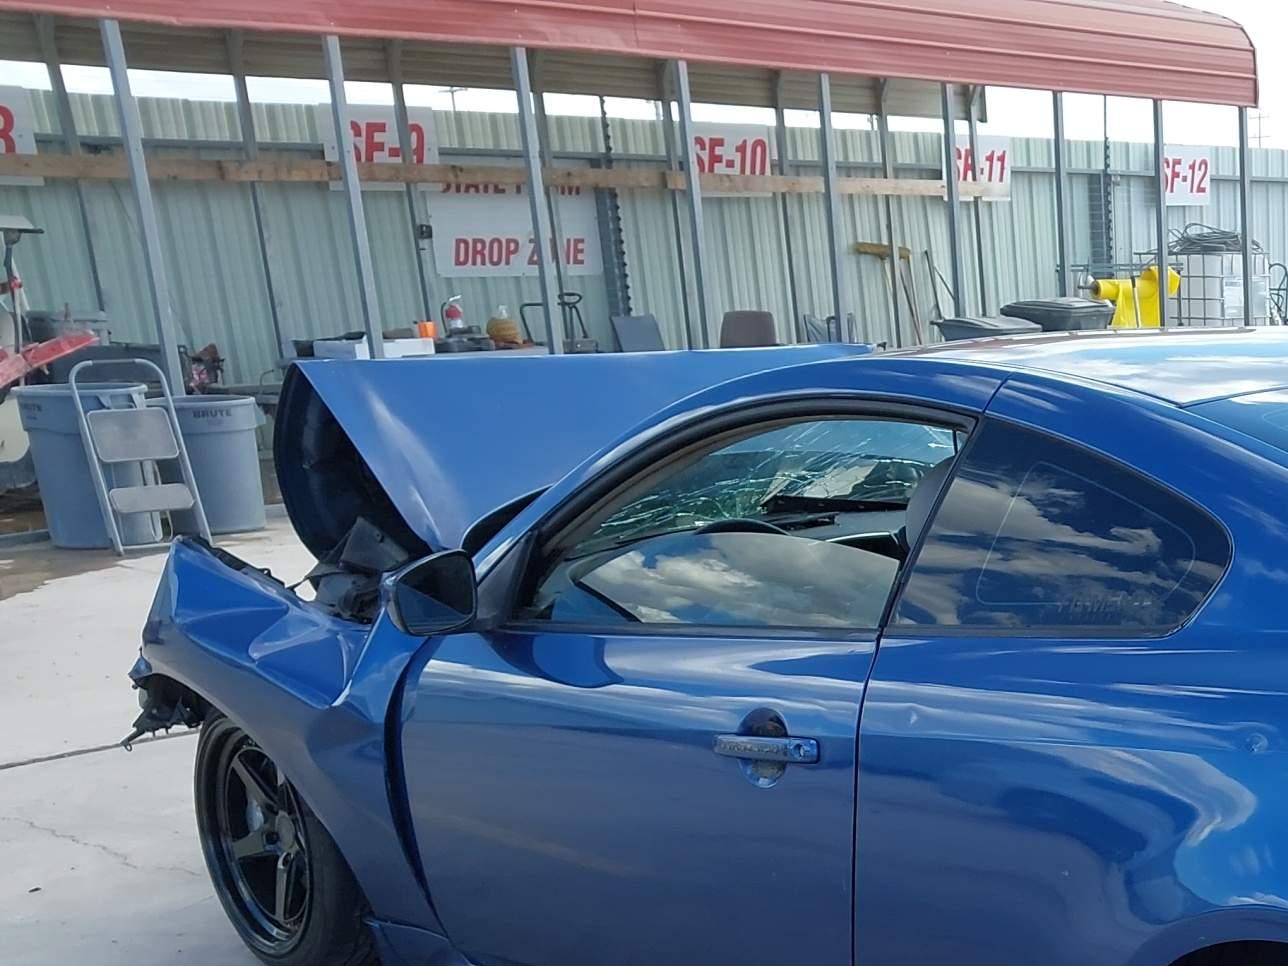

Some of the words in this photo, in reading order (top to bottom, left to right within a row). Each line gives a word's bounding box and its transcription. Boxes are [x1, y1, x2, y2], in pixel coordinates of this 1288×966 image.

[694, 135, 767, 176] SF-10
[1163, 157, 1209, 194] SF-12
[453, 236, 520, 266] DROP
